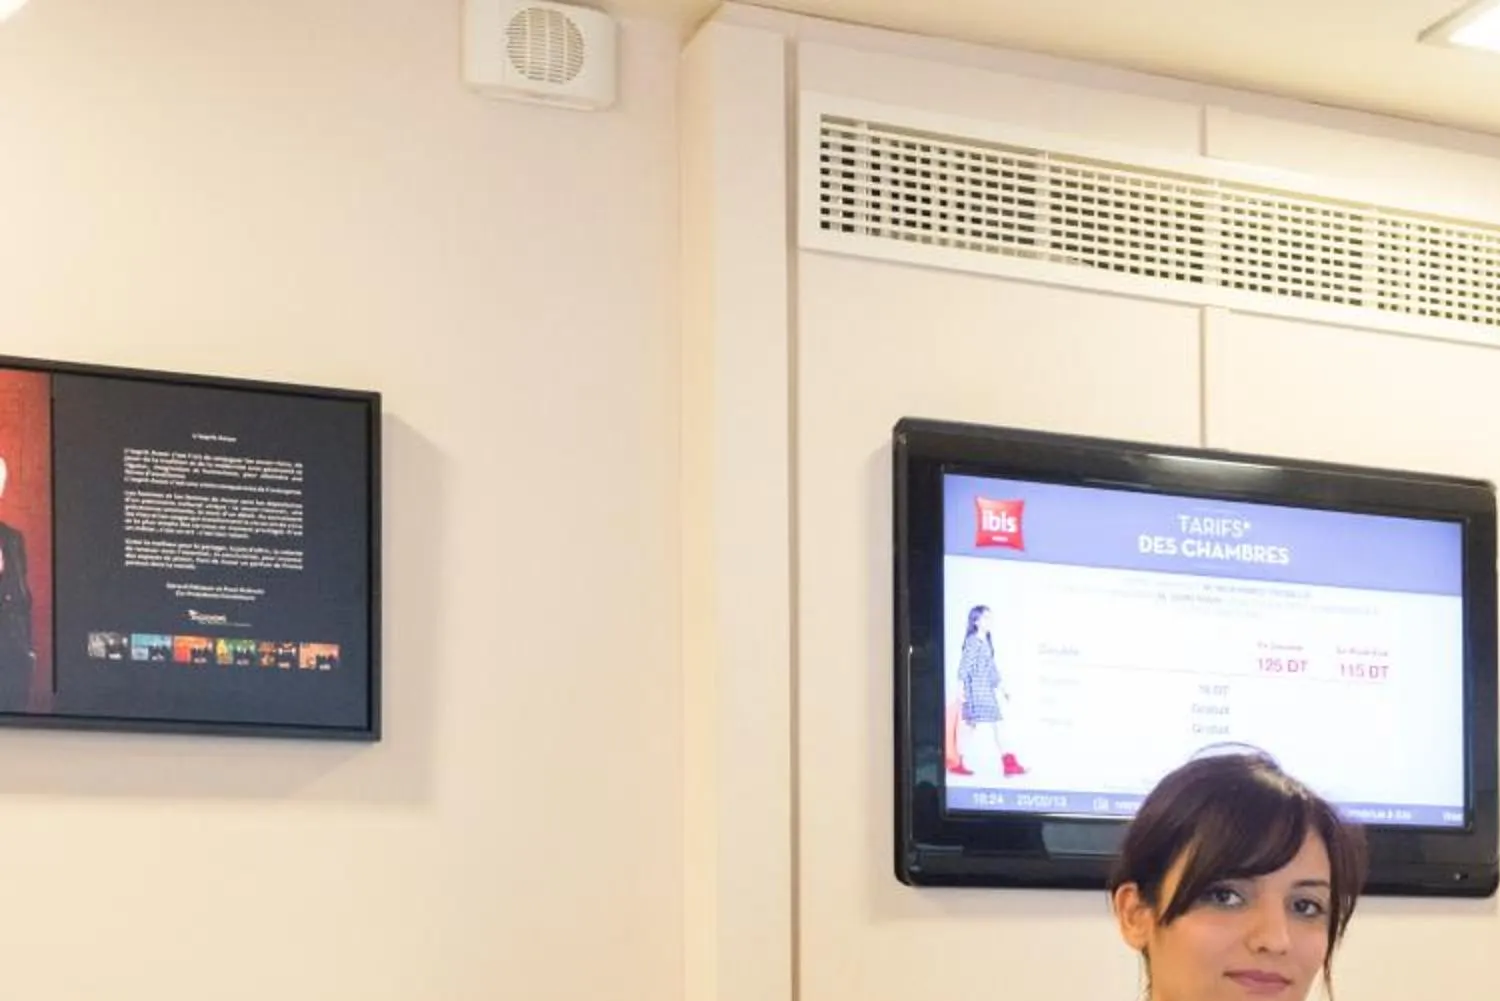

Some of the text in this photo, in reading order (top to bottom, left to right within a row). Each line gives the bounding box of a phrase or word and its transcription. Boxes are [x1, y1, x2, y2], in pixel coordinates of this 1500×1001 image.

[981, 508, 1018, 533] ibis
[1138, 533, 1290, 565] DES CHAMBRES
[1257, 657, 1309, 673] 125 DT
[1340, 663, 1390, 679] 115 DT
